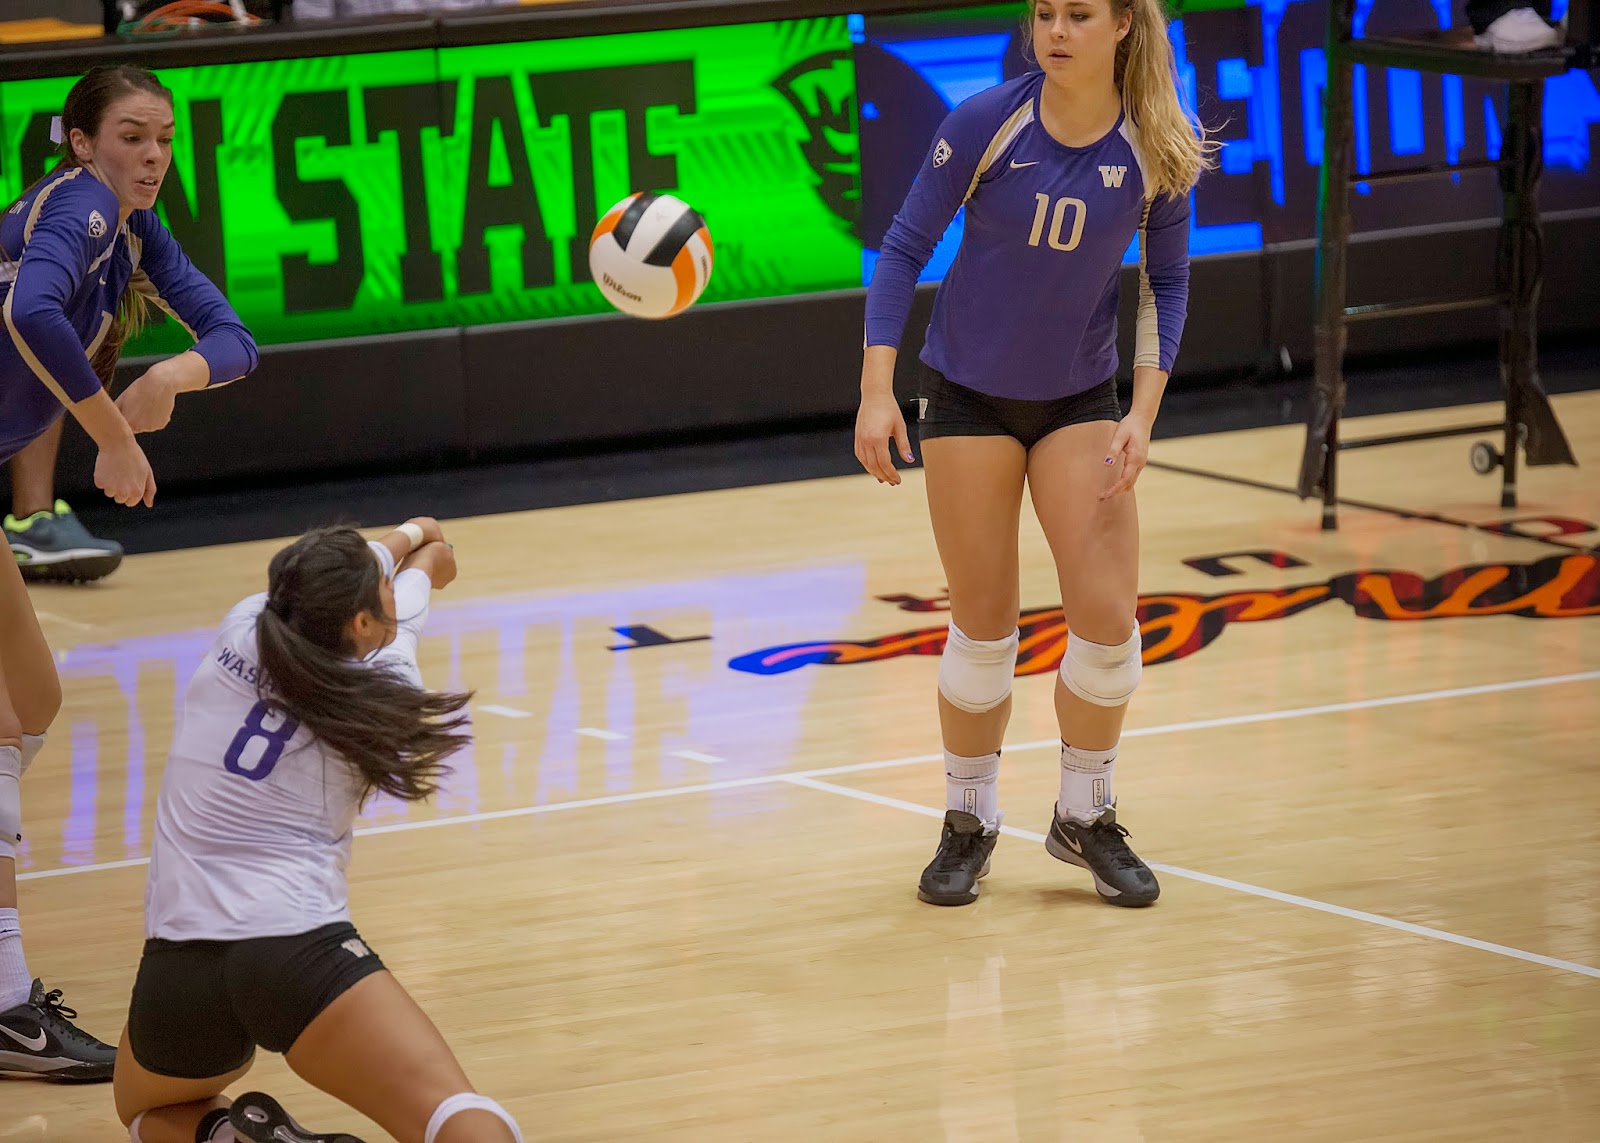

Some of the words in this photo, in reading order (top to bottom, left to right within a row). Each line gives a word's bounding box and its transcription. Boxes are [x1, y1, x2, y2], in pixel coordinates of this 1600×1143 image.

[271, 58, 698, 315] STATE
[1098, 165, 1127, 188] W
[1028, 192, 1087, 252] 10
[602, 271, 643, 303] Wilson
[223, 698, 300, 781] 8
